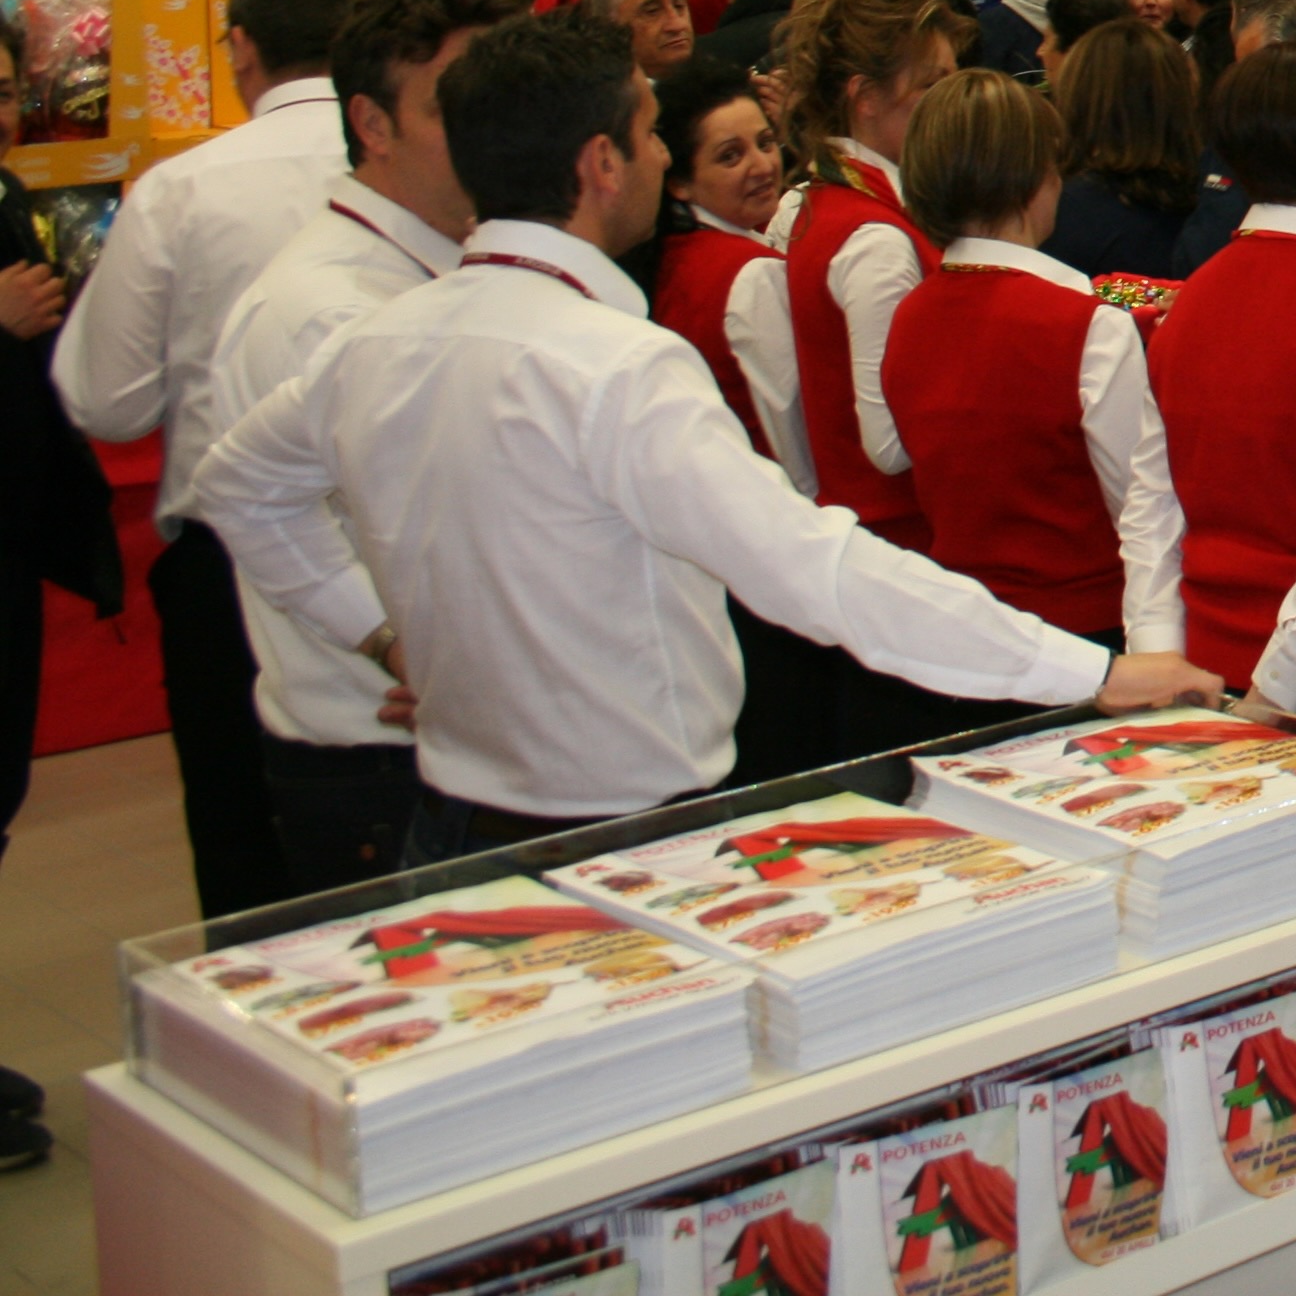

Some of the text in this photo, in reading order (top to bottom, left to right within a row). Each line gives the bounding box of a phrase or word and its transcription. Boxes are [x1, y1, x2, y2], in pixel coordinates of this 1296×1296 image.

[1206, 1010, 1276, 1041] POTENZA
[1056, 1071, 1124, 1104] POTENZA
[881, 1131, 967, 1163] POTENZA
[705, 1190, 786, 1227] POTENZA
